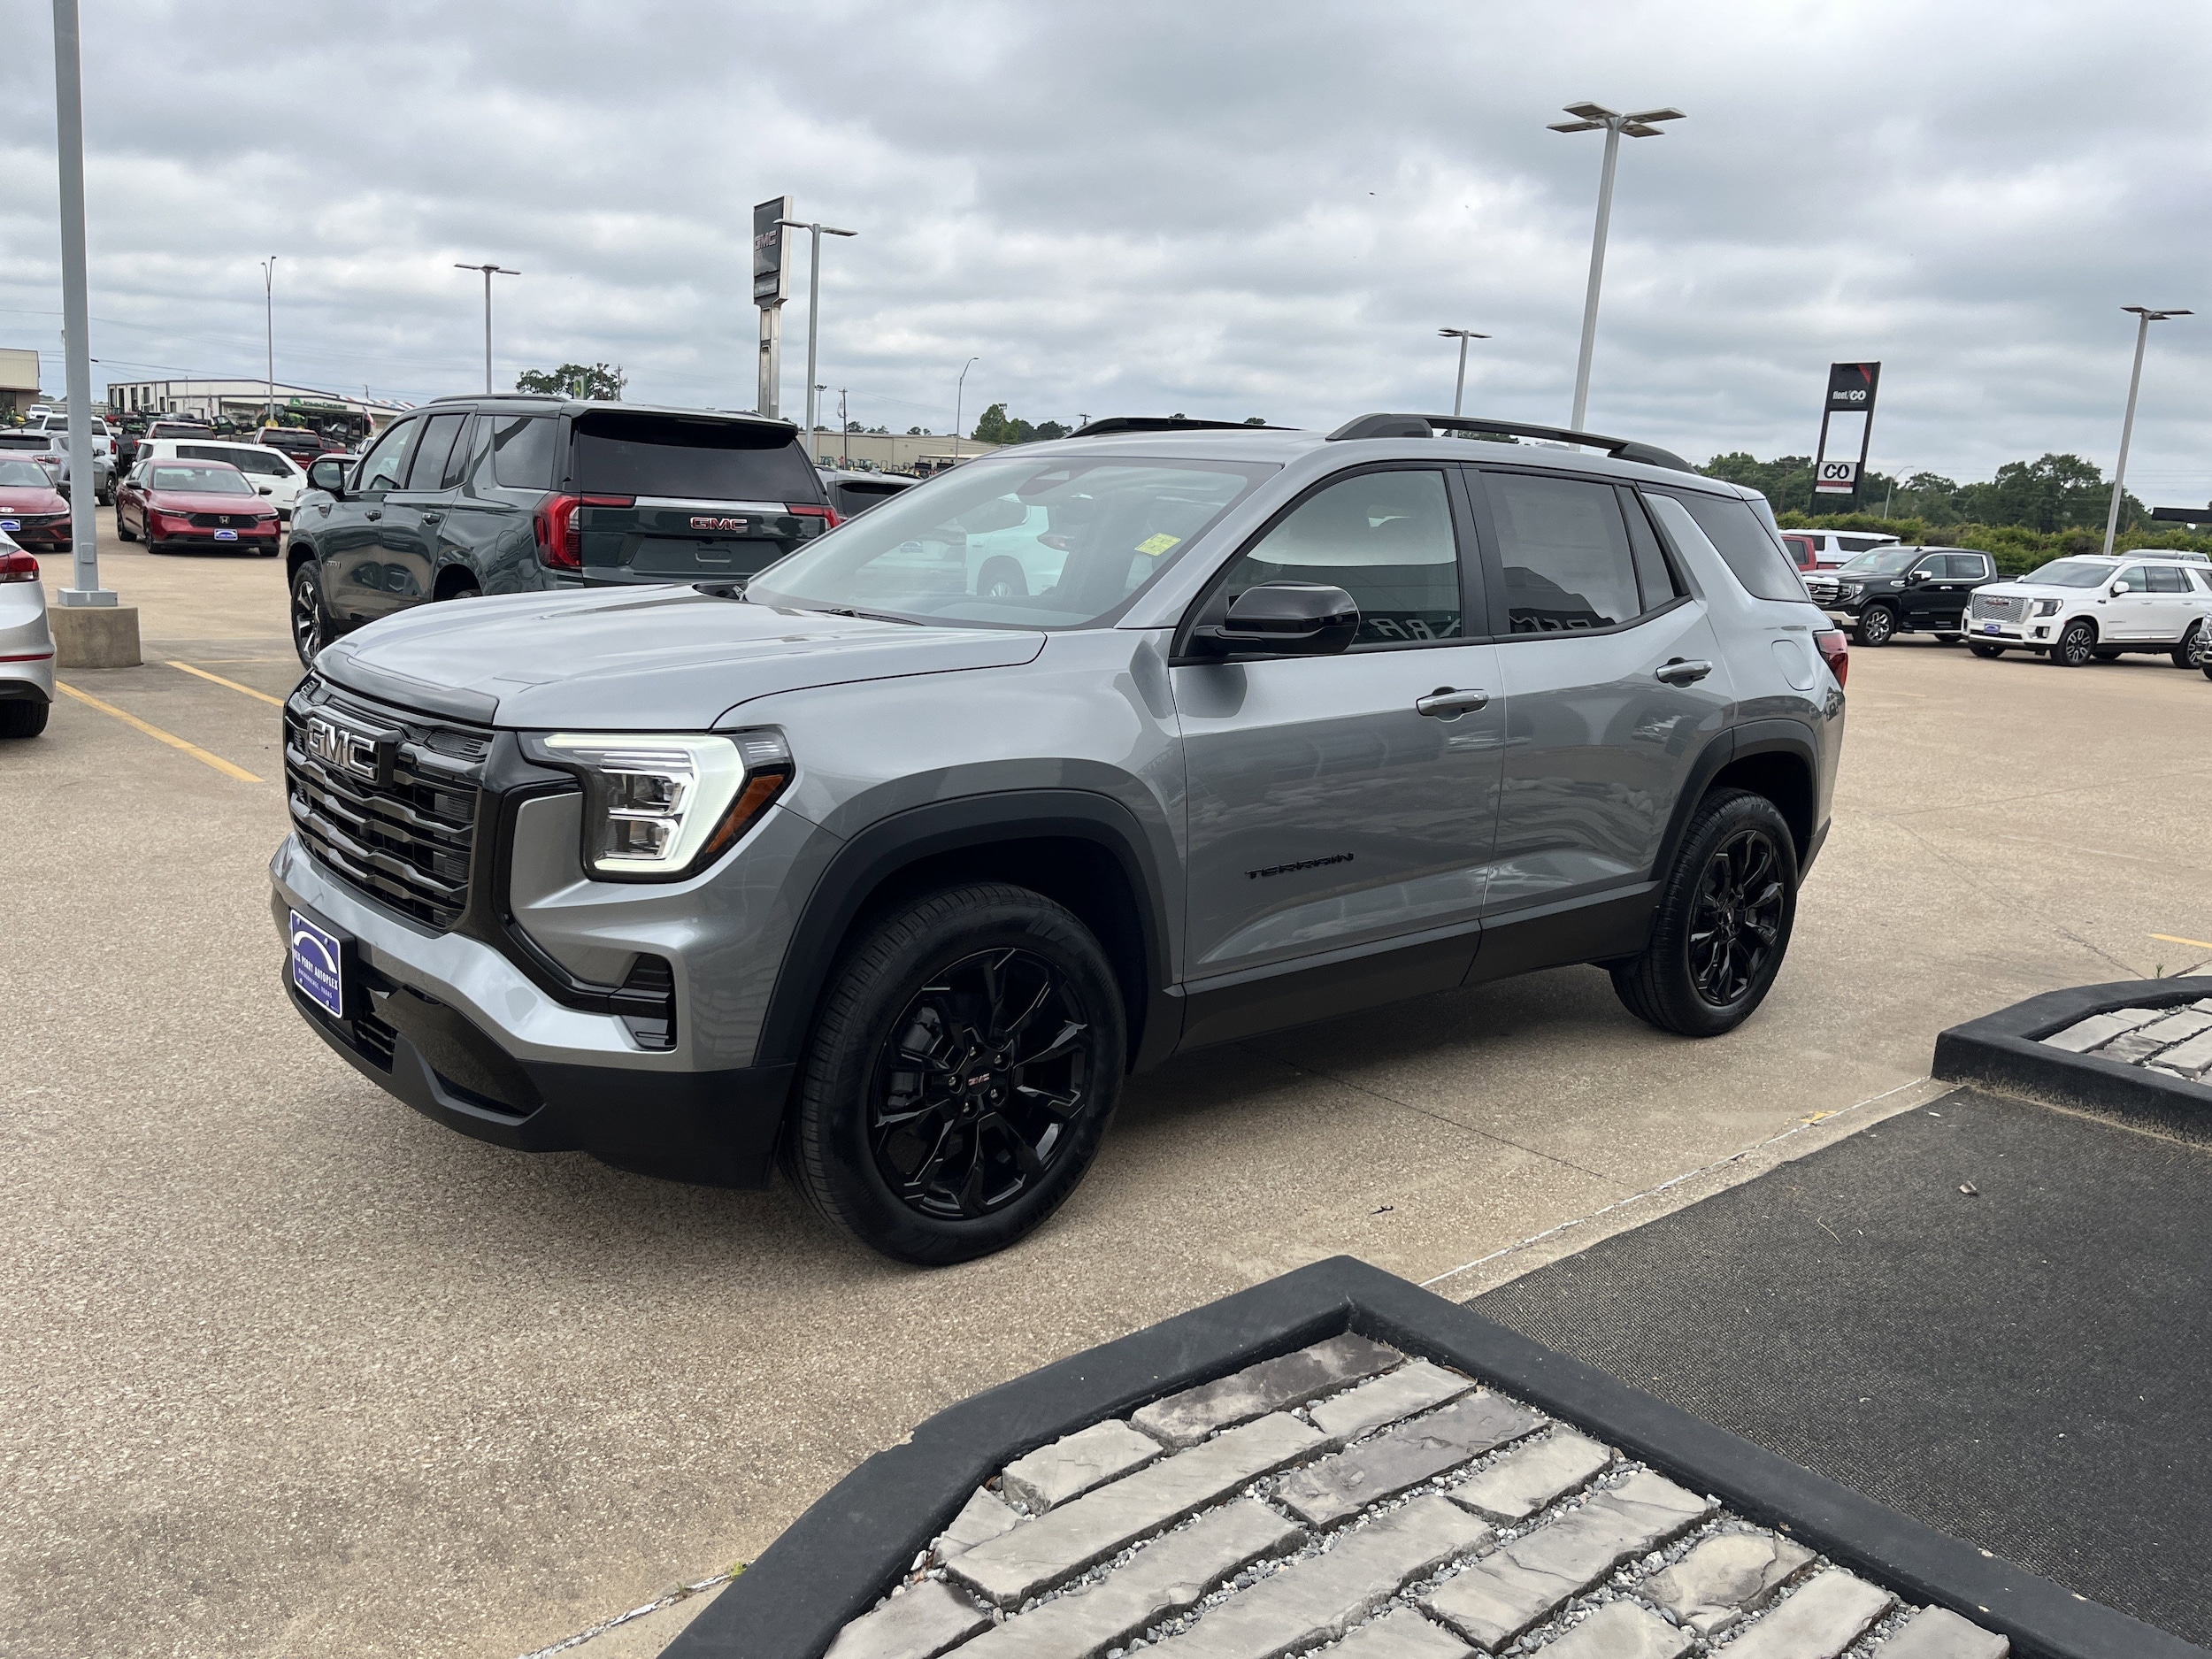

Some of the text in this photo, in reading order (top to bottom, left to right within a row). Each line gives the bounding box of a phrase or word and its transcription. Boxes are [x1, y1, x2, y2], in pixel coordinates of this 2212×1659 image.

[755, 230, 777, 250] GMC
[1824, 464, 1849, 479] GO
[690, 517, 748, 532] GMC
[308, 717, 376, 780] GMC
[1245, 852, 1354, 879] TERRAIN
[302, 956, 313, 972] PERRY
[314, 966, 338, 990] AUTOPLEX
